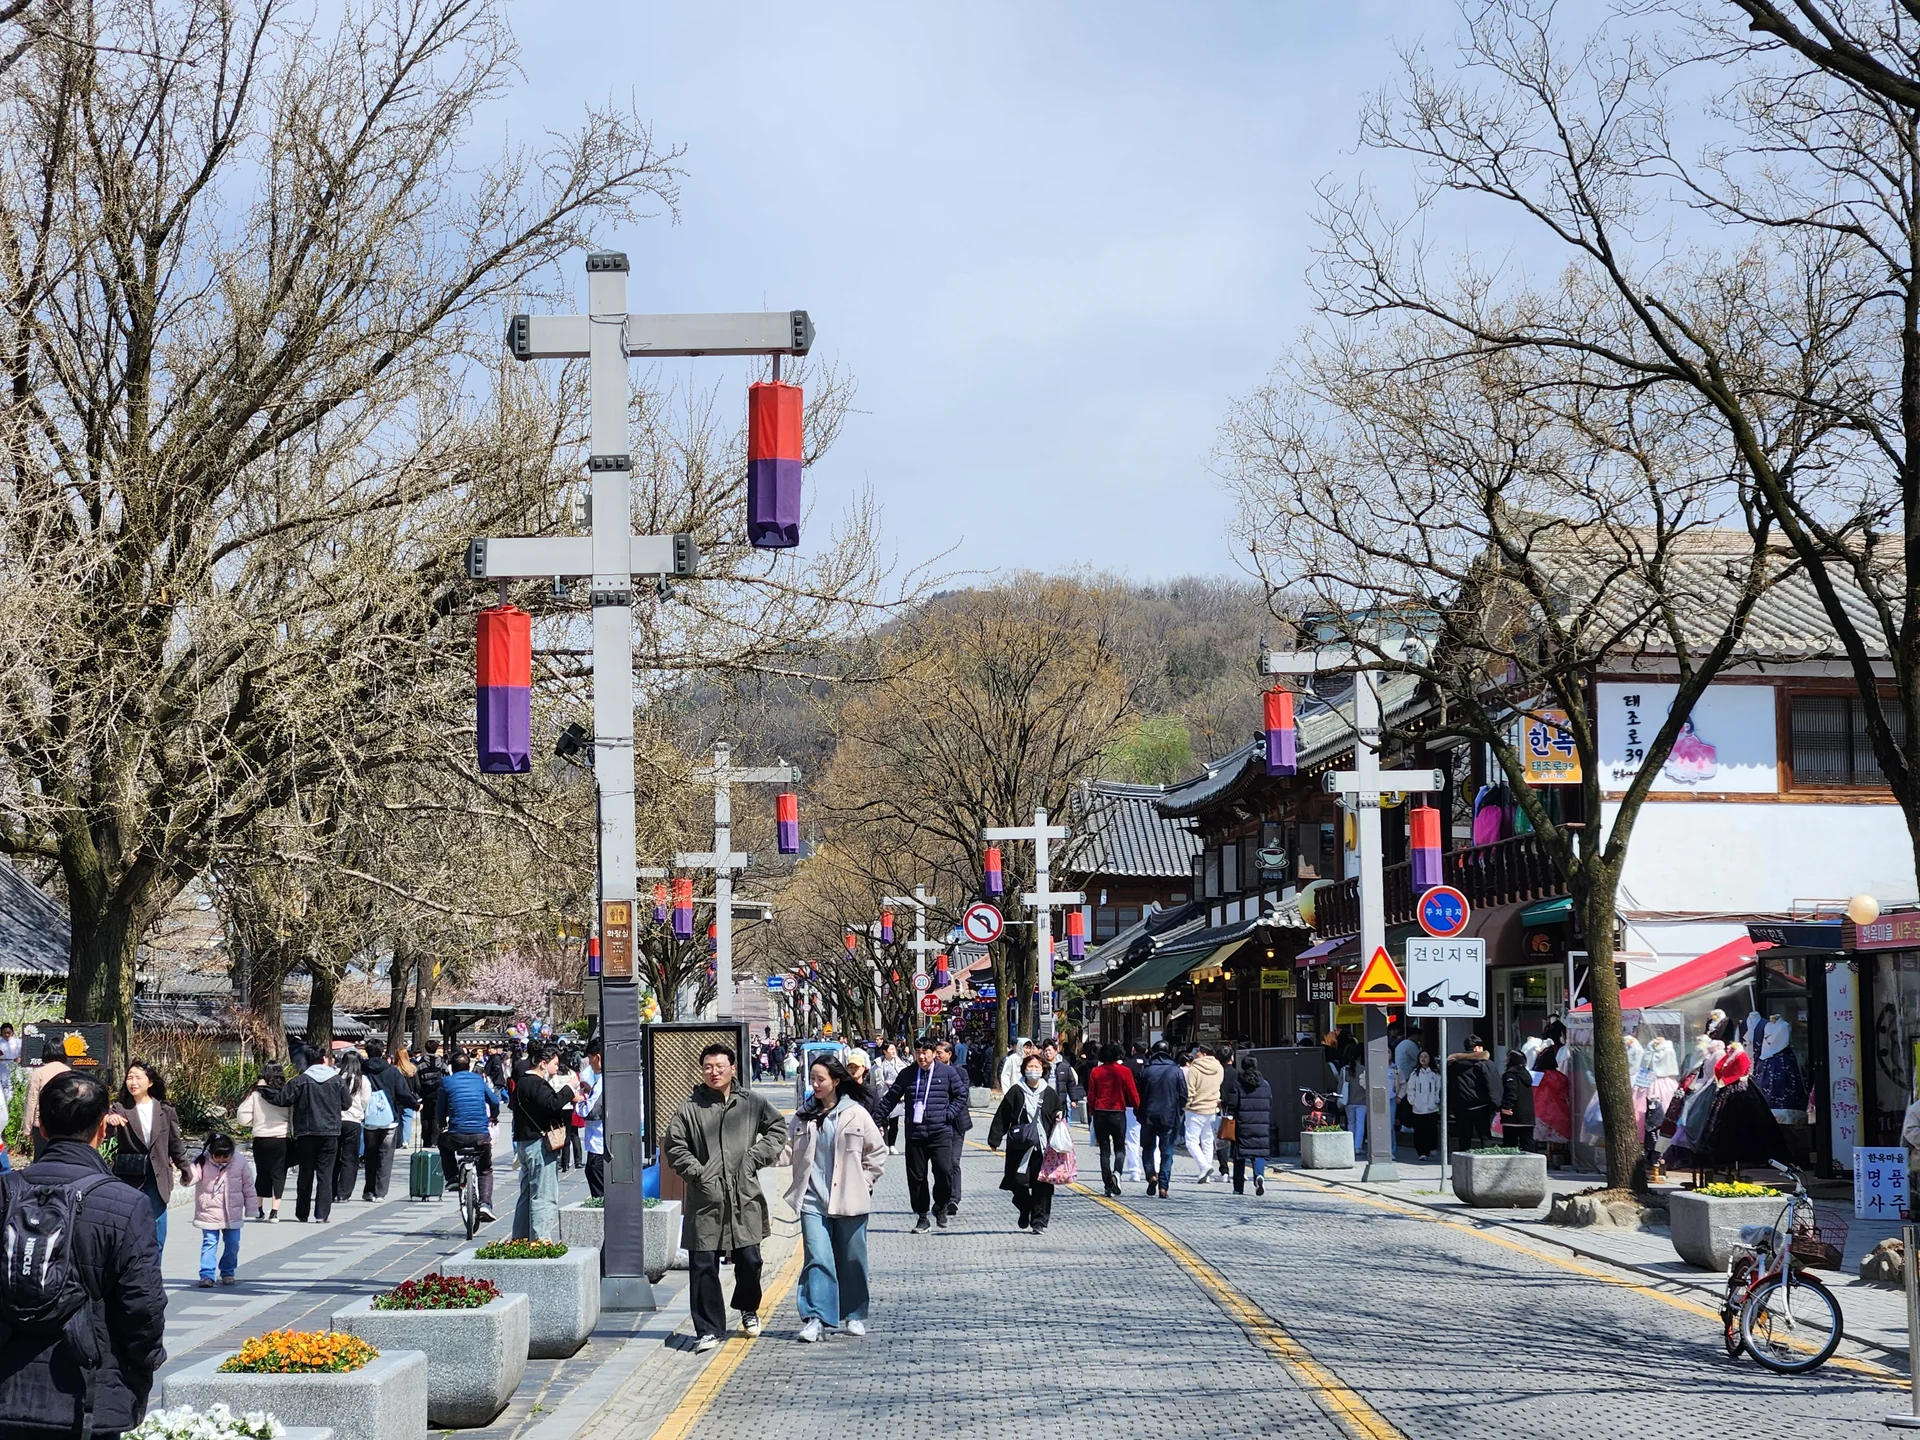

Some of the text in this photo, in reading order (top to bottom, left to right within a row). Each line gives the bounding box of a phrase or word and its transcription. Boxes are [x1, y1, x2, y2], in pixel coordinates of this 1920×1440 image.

[1623, 694, 1644, 763] 태조로39
[1528, 719, 1576, 758] 한복
[1531, 760, 1575, 772] 태조로39
[1425, 908, 1462, 917] 주차금지
[606, 929, 629, 938] 화장실
[1862, 923, 1893, 942] 한옥마을
[1414, 947, 1478, 962] 견인지역
[916, 978, 927, 987] 20
[1311, 991, 1334, 1000] 프라이
[923, 998, 939, 1006] 정지
[1867, 1153, 1905, 1164] 한옥마을
[22, 1237, 37, 1276] HIRCUS
